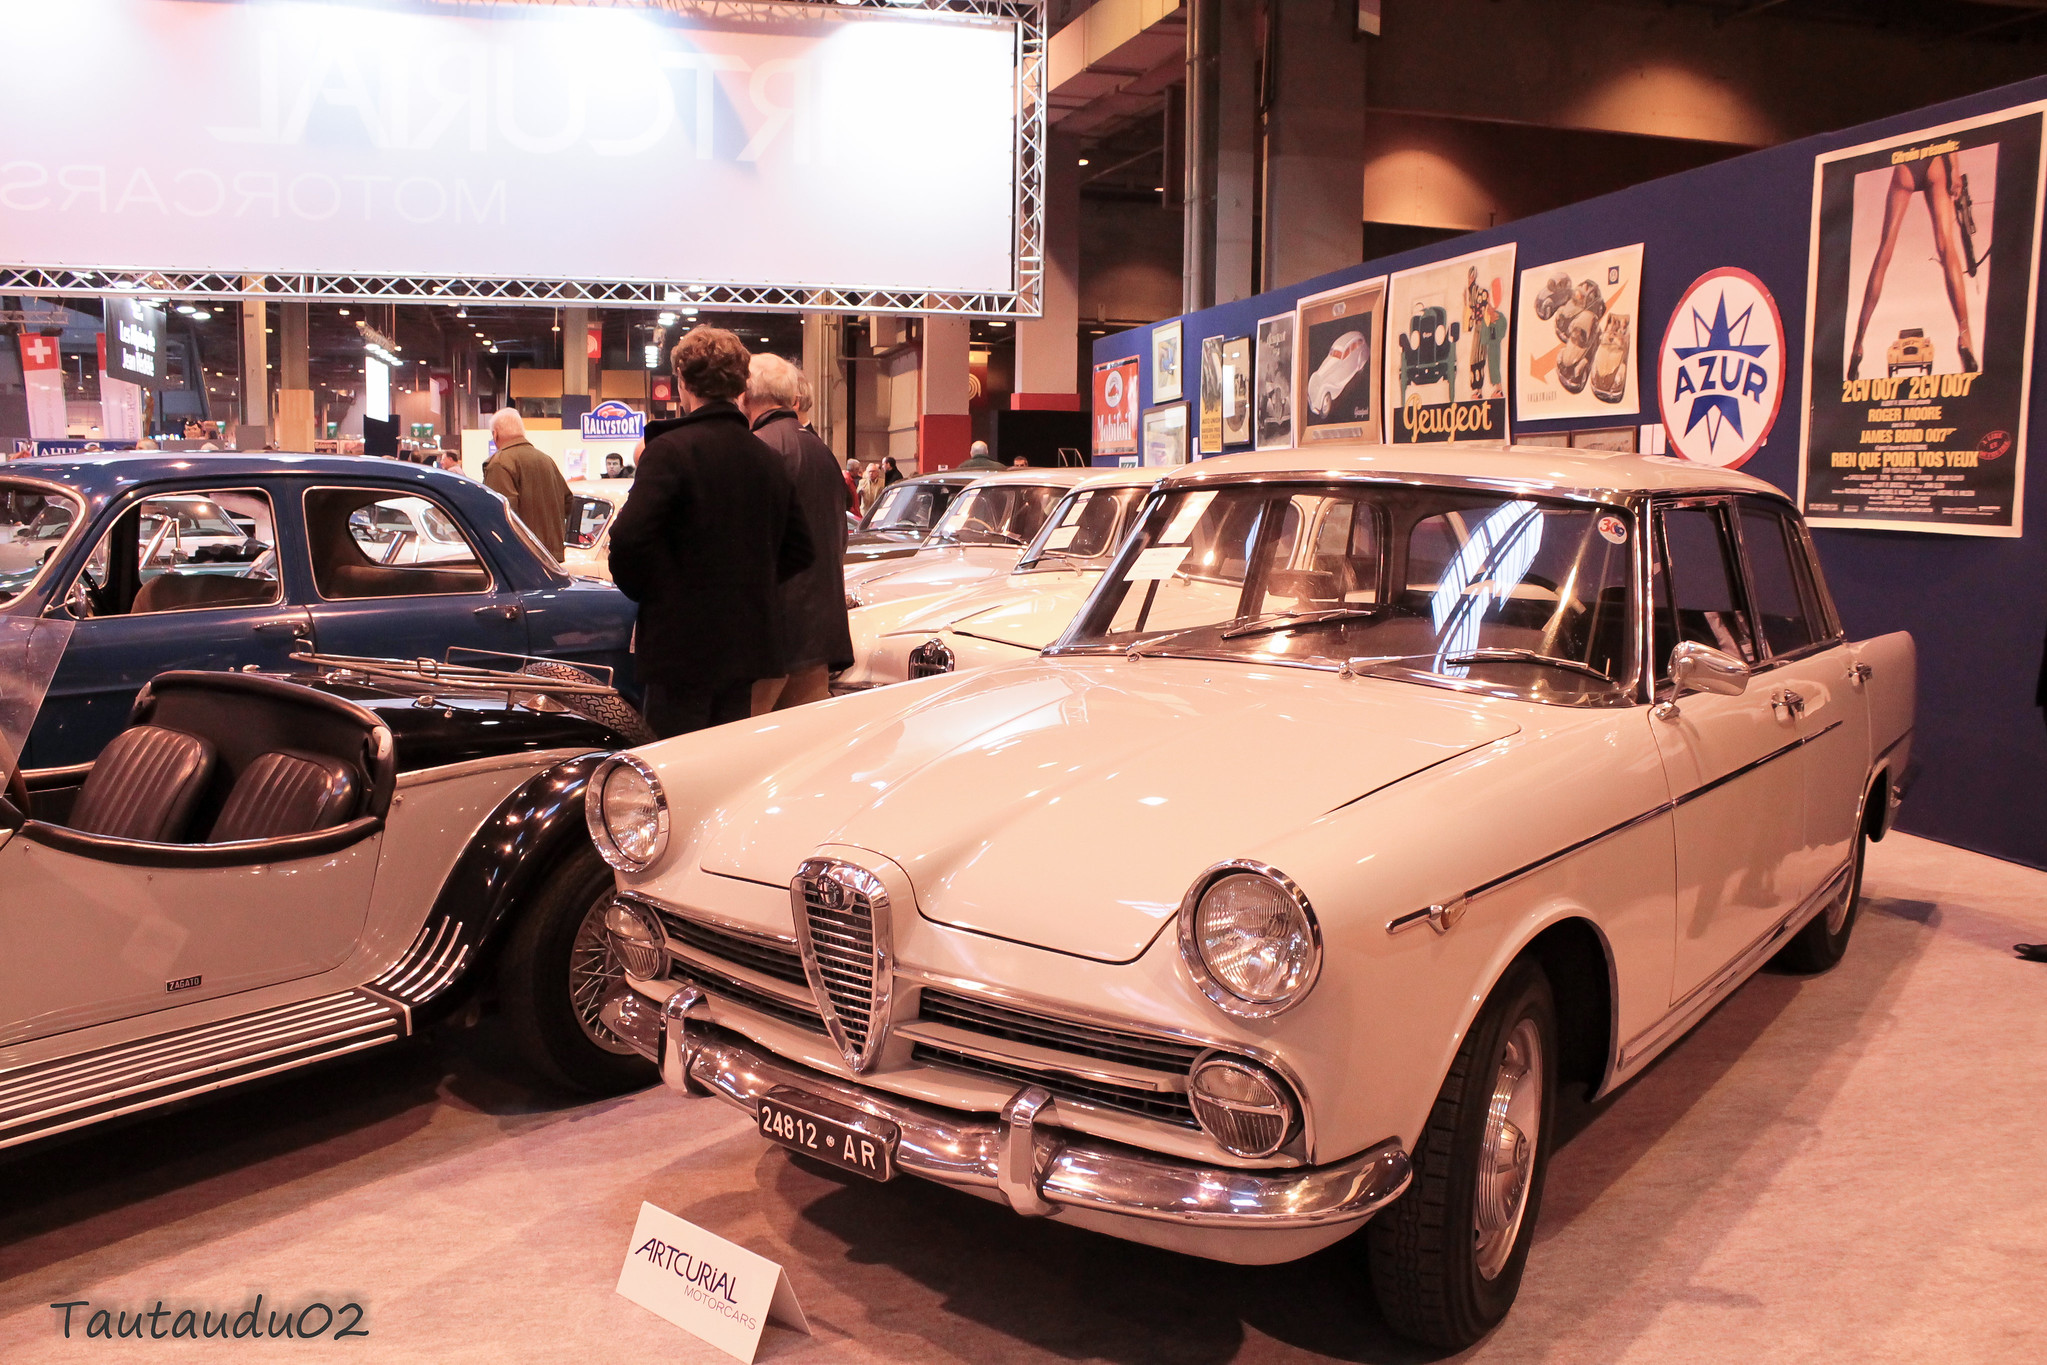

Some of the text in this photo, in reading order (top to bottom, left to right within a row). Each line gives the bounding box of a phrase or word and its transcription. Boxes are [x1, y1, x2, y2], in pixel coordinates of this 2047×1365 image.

[1674, 355, 1768, 404] AZUR
[1842, 372, 1983, 402] 2CV 007 2CV 007
[583, 413, 642, 435] RALLYSTORY
[1403, 393, 1492, 444] Peugeot
[1868, 406, 1943, 422] ROGER MOORE
[1860, 428, 1958, 444] JAMES BOND 007
[1831, 452, 1857, 468] RIEN
[1858, 452, 1882, 471] QUE
[1883, 452, 1916, 468] POUR
[1917, 452, 1945, 467] VOS
[1945, 451, 1979, 467] YEUX
[170, 977, 200, 991] ZAGATO
[762, 1106, 876, 1170] 24812 AR
[683, 1284, 757, 1331] MOTORCARS
